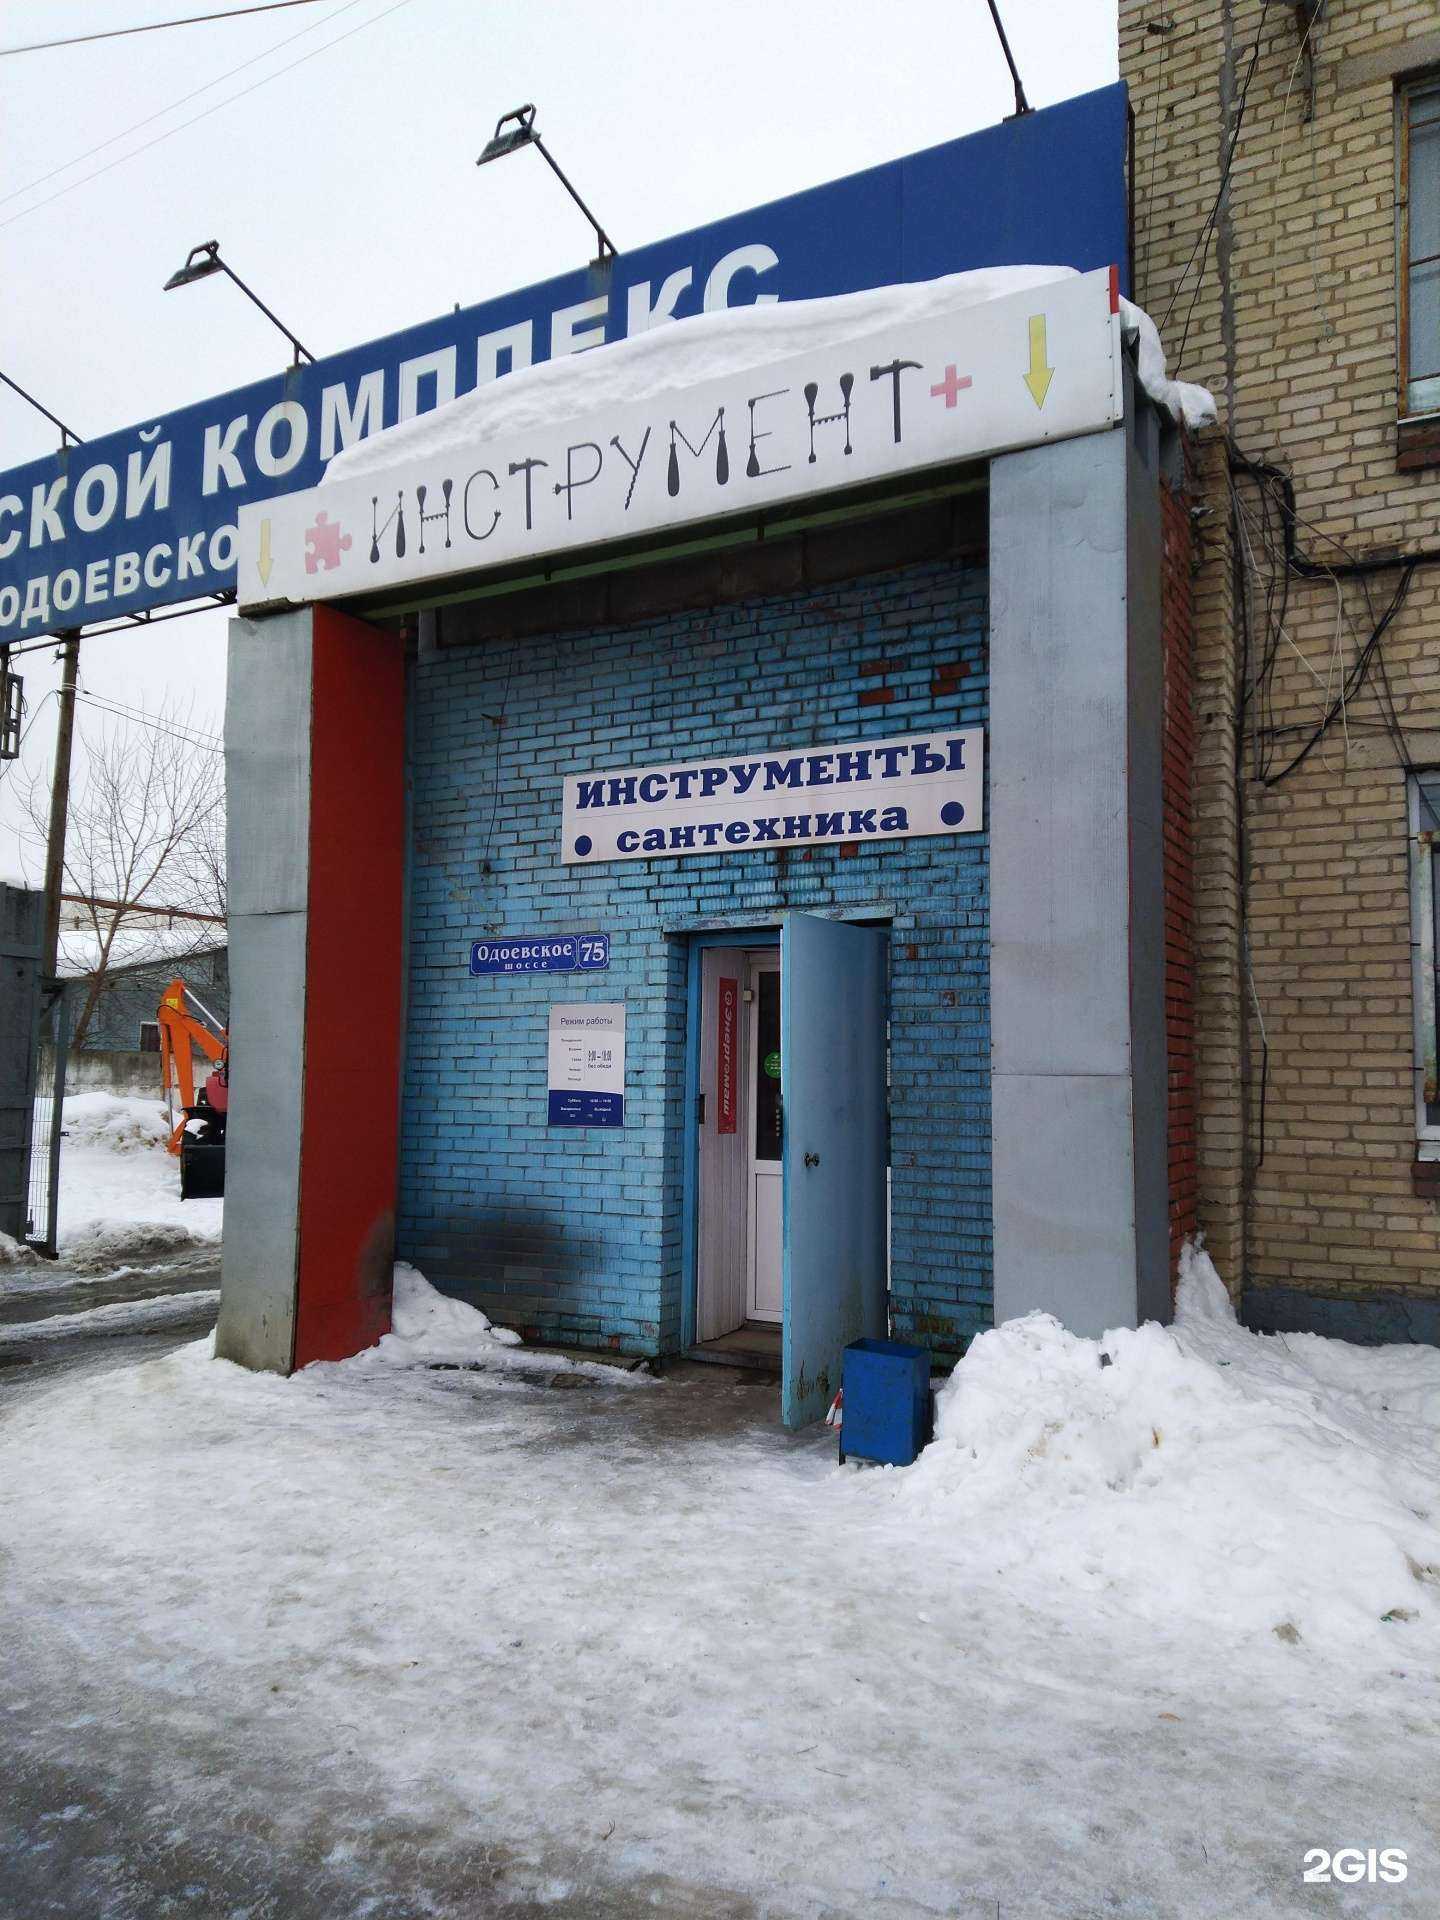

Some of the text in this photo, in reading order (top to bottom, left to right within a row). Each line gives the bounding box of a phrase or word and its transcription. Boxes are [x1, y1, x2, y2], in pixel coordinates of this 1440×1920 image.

[369, 358, 924, 564] ИНСТРУМЕНТ
[576, 738, 966, 810] ИНСТРУМЕНТЫ
[616, 806, 909, 853] сантехника
[477, 942, 605, 963] Одоевское 75
[504, 960, 548, 970] шоссе
[560, 1016, 613, 1027] Режим работы
